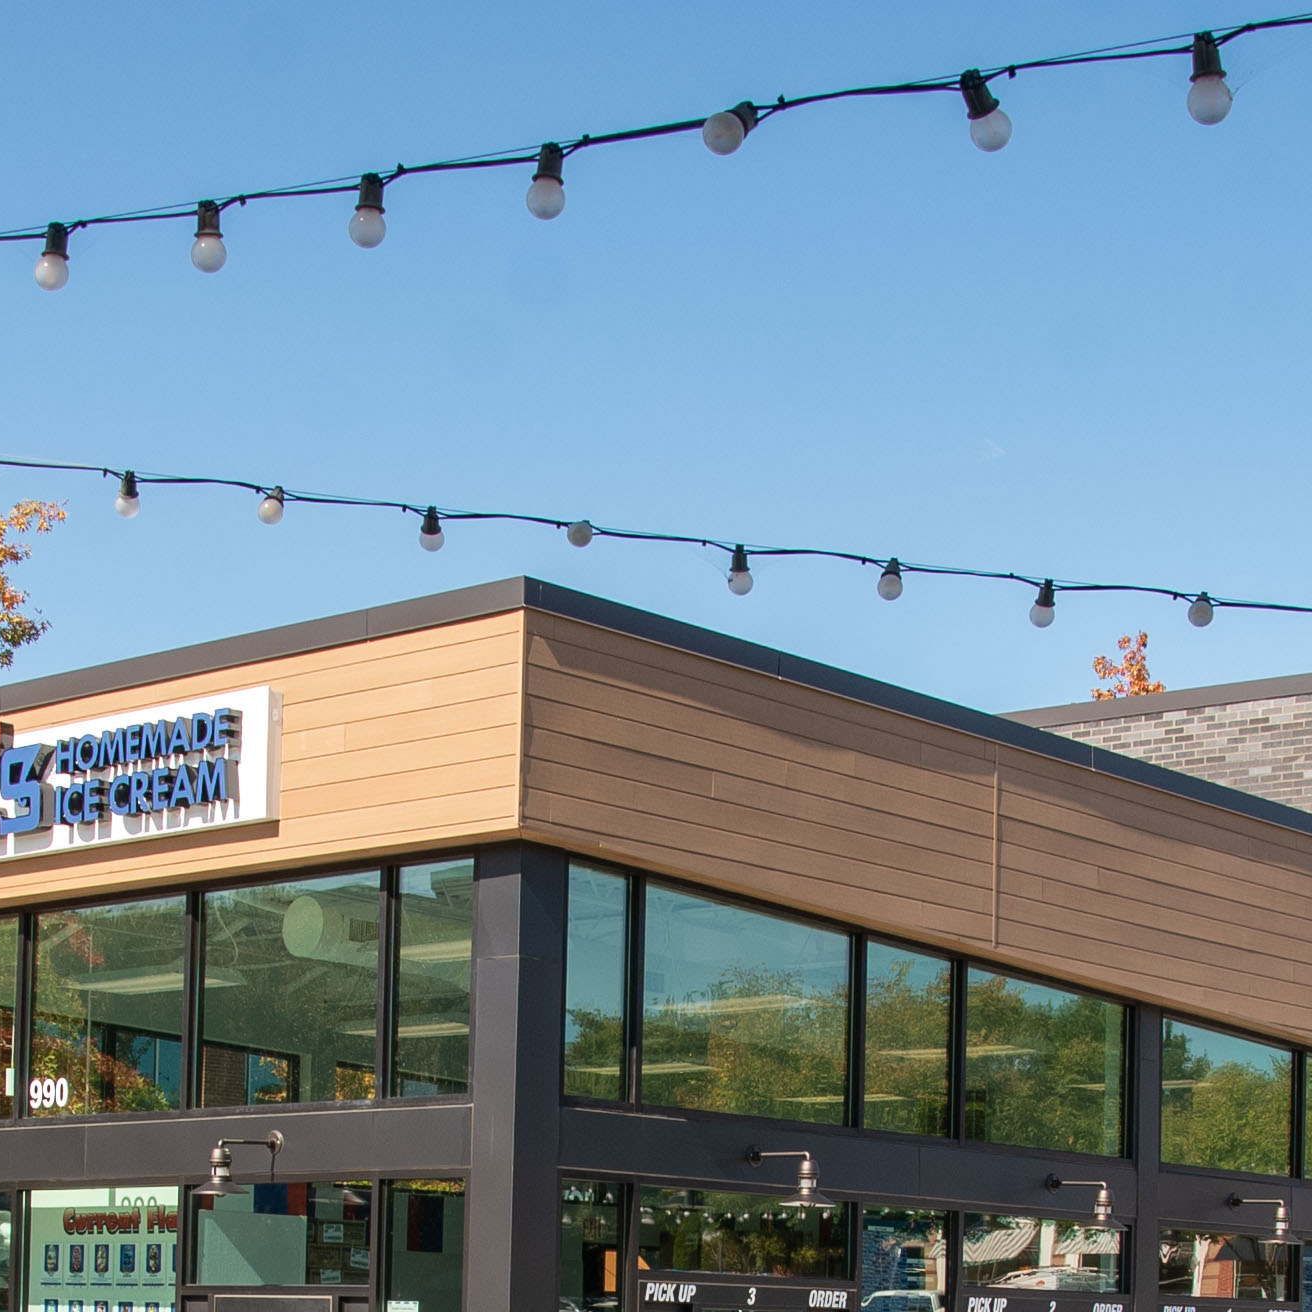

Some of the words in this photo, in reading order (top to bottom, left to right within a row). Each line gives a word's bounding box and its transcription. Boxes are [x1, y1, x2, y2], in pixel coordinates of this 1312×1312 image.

[56, 708, 231, 773] HOMEMADE
[55, 783, 100, 825] ICE
[109, 757, 228, 815] CREAM
[30, 1077, 68, 1109] 990
[63, 1206, 141, 1235] Current
[644, 1282, 675, 1302] PICK
[678, 1284, 696, 1303] UP
[747, 1287, 756, 1306] 3
[808, 1289, 848, 1309] ORDER
